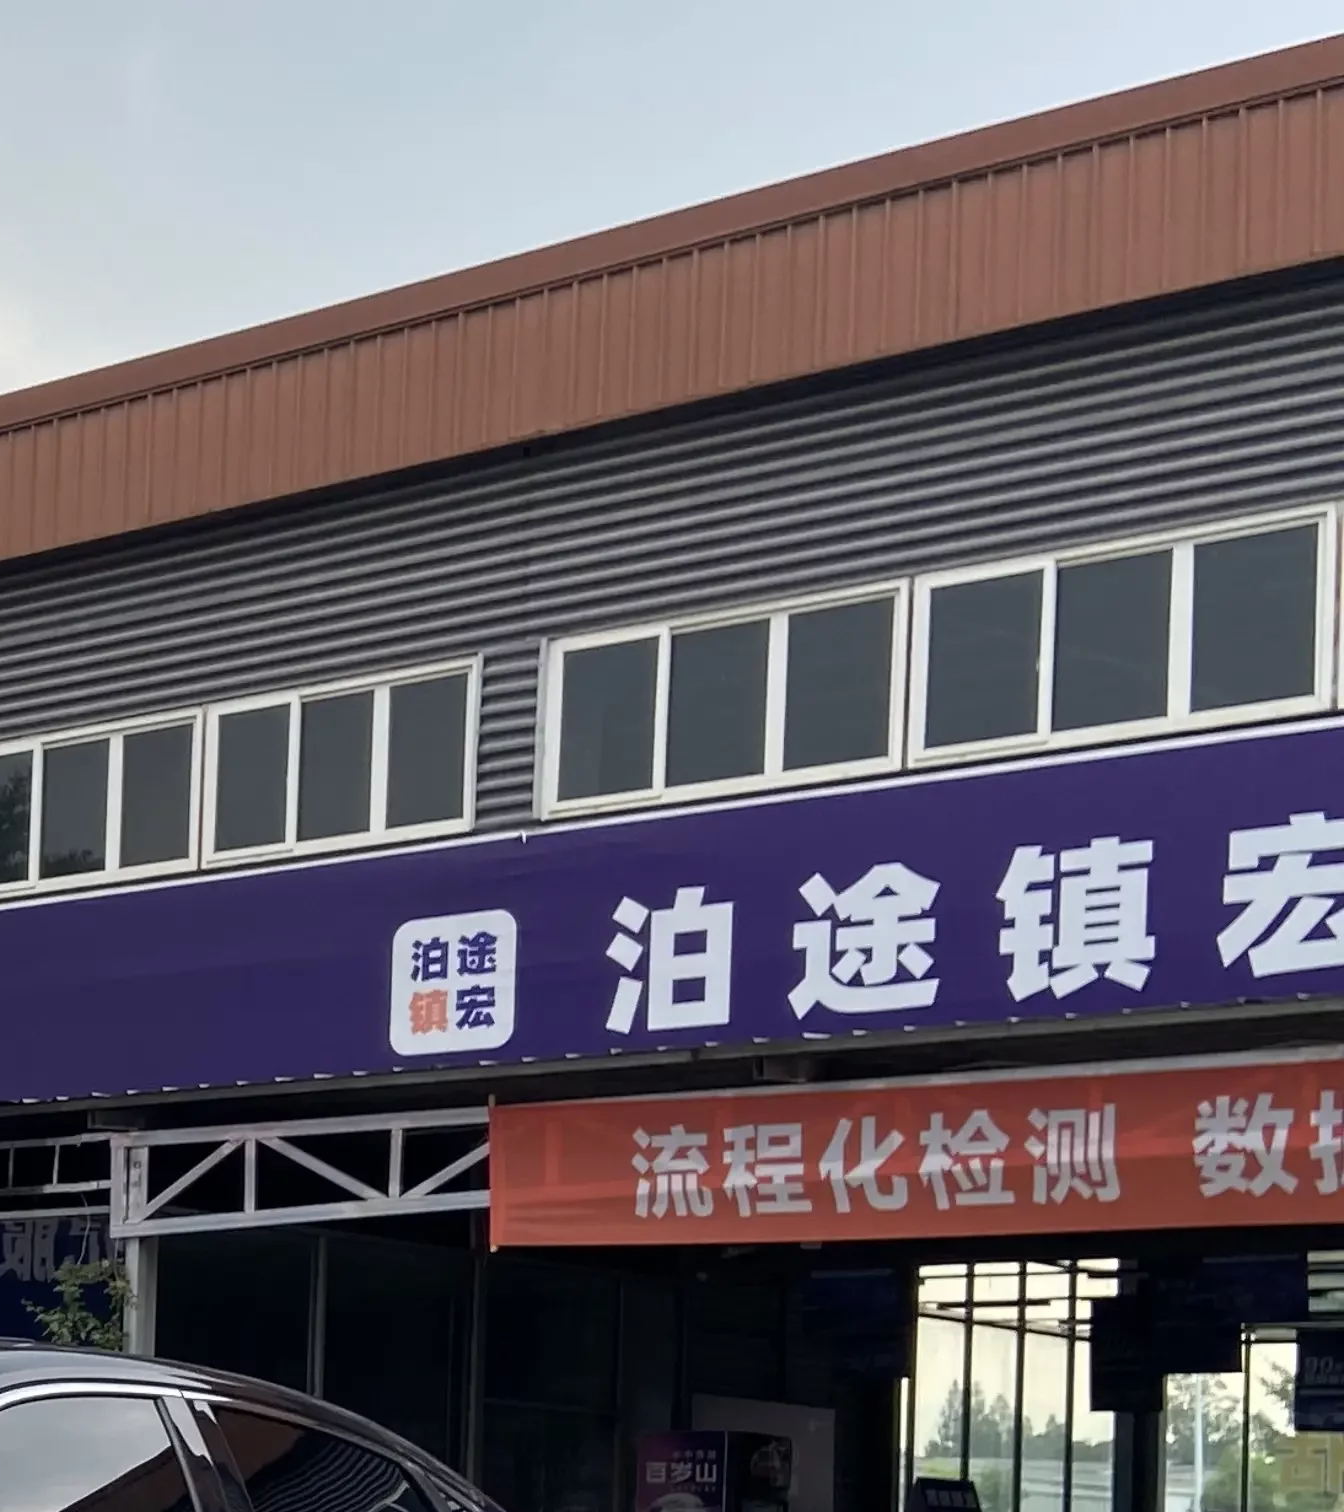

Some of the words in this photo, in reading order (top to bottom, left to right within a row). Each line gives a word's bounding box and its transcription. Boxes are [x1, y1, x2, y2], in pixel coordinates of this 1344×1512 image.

[604, 812, 1344, 1035] 泊途镇宏
[411, 931, 498, 981] 泊途
[408, 983, 497, 1034] 镇宏
[631, 1102, 1121, 1220] 流程化检测
[645, 1462, 717, 1483] 百岁山
